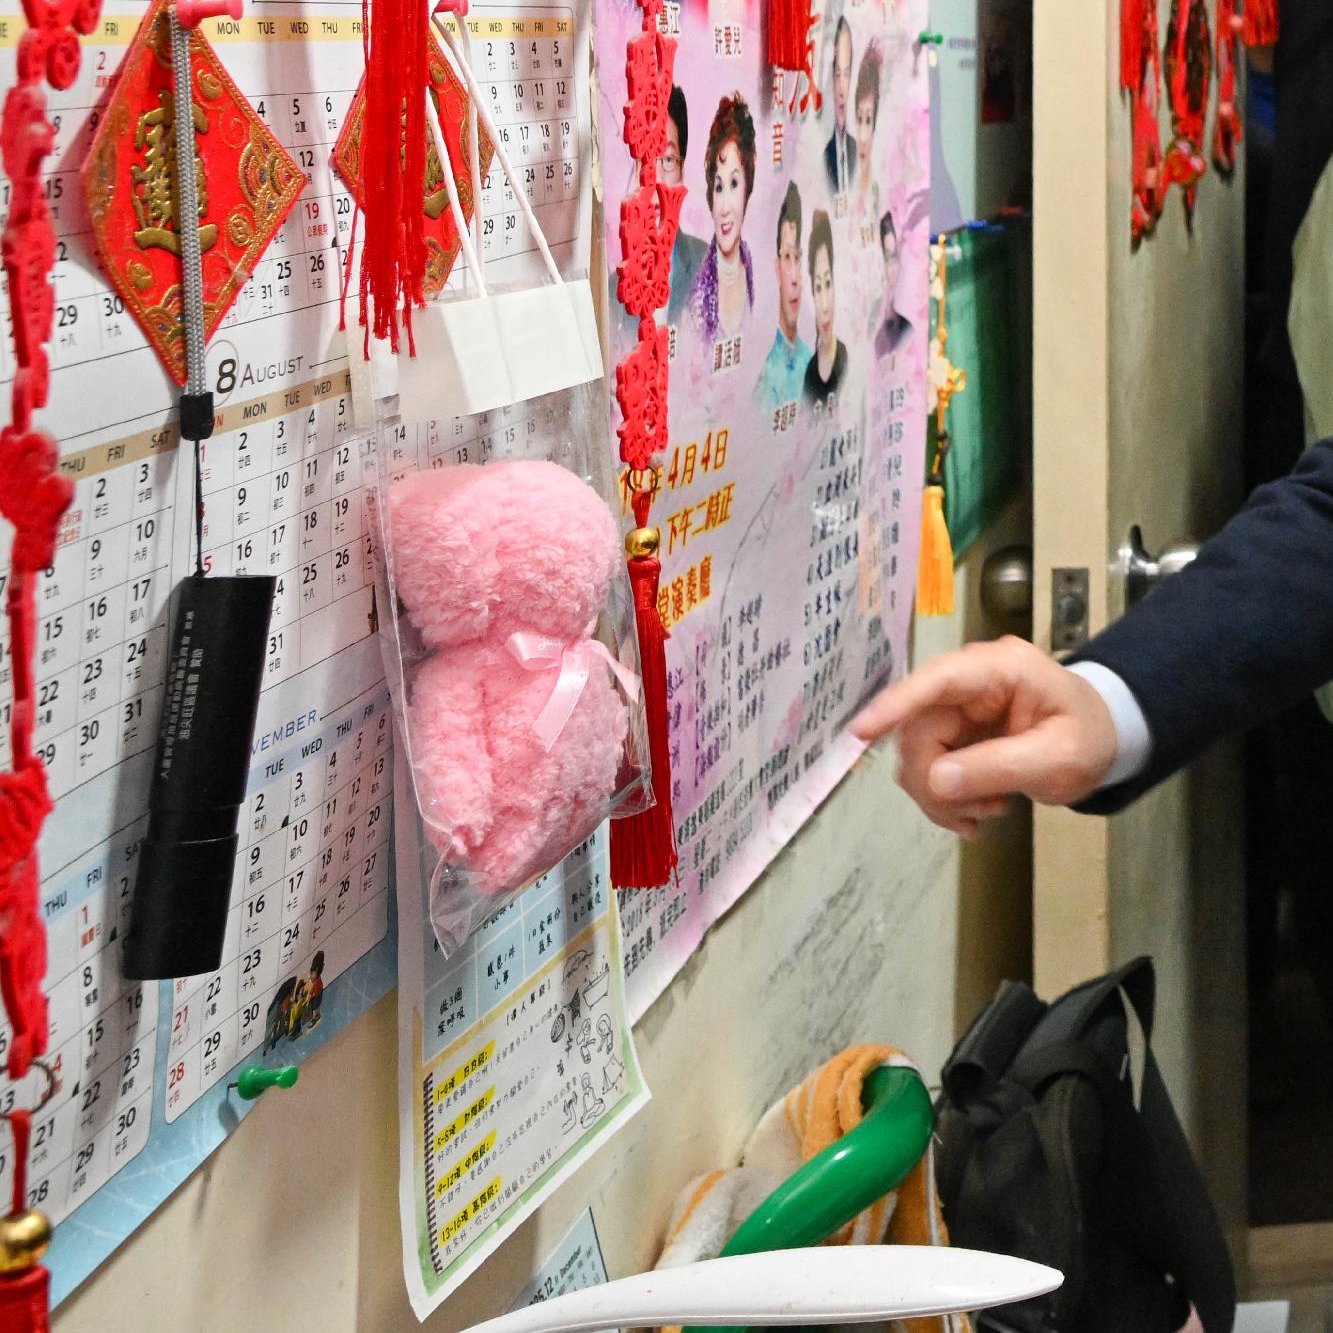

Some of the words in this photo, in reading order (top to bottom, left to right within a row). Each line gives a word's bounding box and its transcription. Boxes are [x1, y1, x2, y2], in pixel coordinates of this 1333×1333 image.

[106, 23, 118, 35] FRI
[218, 22, 239, 34] MON
[258, 22, 275, 34] TUE
[290, 22, 308, 34] WED
[322, 22, 337, 33] THU
[489, 22, 502, 32] WED
[512, 22, 524, 32] THU
[535, 22, 543, 32] FRI
[557, 22, 566, 32] SAT
[510, 42, 515, 55] 3
[98, 52, 105, 70] 2
[492, 86, 497, 99] 9
[557, 82, 566, 94] 12
[326, 97, 332, 112] 6
[541, 124, 550, 137] 18
[546, 165, 554, 179] 25
[337, 198, 349, 214] 20
[506, 216, 515, 230] 30
[310, 254, 324, 272] 26
[104, 298, 122, 314] 30
[216, 358, 237, 393] 8
[240, 357, 303, 387] AUGUST
[243, 402, 266, 419] MON
[285, 391, 300, 406] TUE
[314, 380, 332, 396] WED
[278, 421, 284, 438] 3
[395, 426, 406, 442] 14
[108, 444, 125, 462] FRI
[151, 430, 170, 448] SAT
[238, 488, 246, 506] 9
[337, 448, 348, 466] 12
[305, 512, 317, 530] 18
[92, 540, 100, 560] 9
[303, 564, 316, 584] 25
[45, 616, 62, 640] 15
[39, 680, 58, 706] 22
[80, 720, 99, 746] 30
[251, 709, 318, 755] VEMBER
[266, 758, 284, 778] TUE
[302, 738, 322, 758] WED
[337, 719, 352, 738] THU
[364, 703, 374, 719] FRI
[330, 752, 336, 767] 4
[379, 714, 385, 729] 6
[327, 798, 336, 818] 11
[248, 895, 264, 918] 16
[346, 826, 355, 847] 19
[45, 891, 67, 916] THU
[87, 866, 102, 887] FRI
[207, 976, 220, 1002] 22
[315, 898, 326, 922] 25
[87, 1022, 104, 1044] 15
[169, 1062, 184, 1089] 28
[82, 1081, 101, 1112] 22
[116, 1107, 136, 1136] 30
